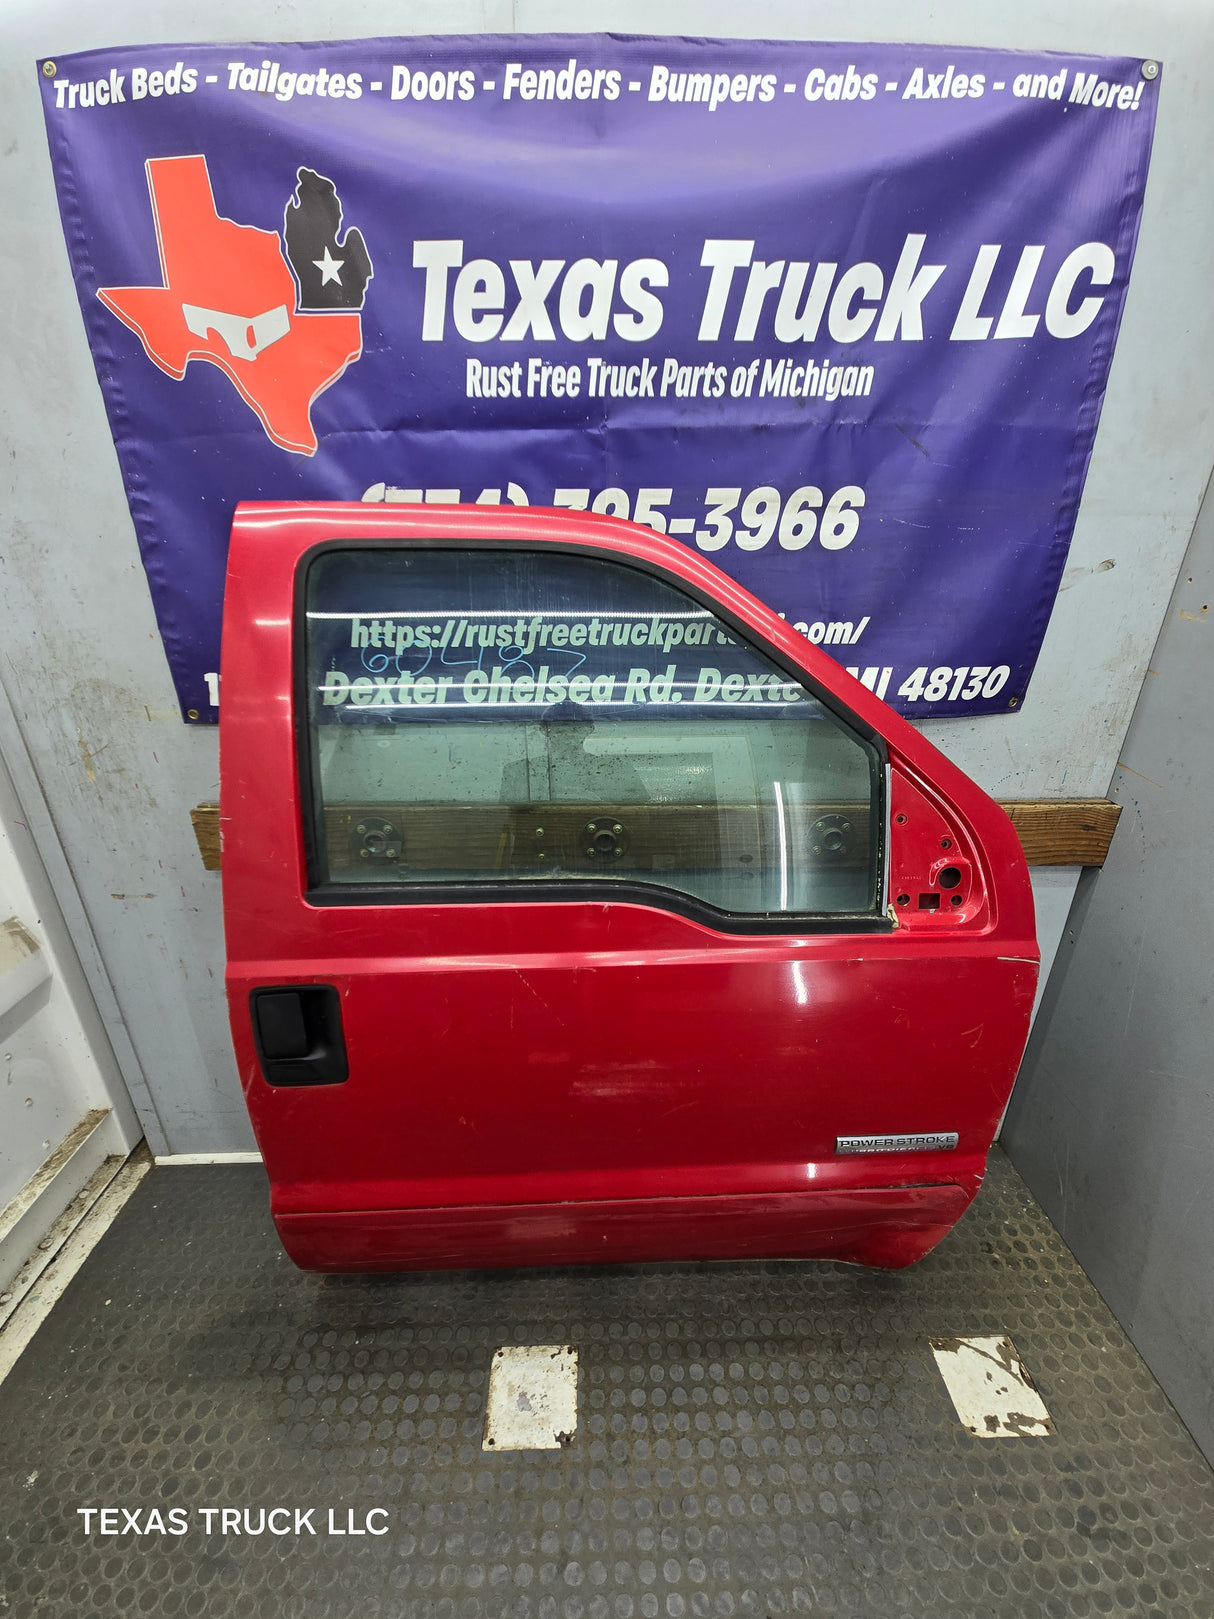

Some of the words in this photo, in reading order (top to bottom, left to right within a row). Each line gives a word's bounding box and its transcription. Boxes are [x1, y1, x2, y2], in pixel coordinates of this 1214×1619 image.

[53, 66, 126, 109] Truck
[131, 61, 198, 97] Beds
[227, 62, 363, 102] Tailgates
[390, 64, 475, 101] Doors
[503, 59, 621, 101] Fenders
[648, 65, 777, 112] Bumpers
[804, 66, 878, 101] Cabs
[902, 65, 986, 99] Axles
[1012, 68, 1068, 100] and
[1069, 72, 1146, 110] More!
[412, 239, 670, 342] Texas
[697, 232, 947, 343] Truck
[949, 241, 1116, 341] LLC
[466, 358, 522, 398] Rust
[526, 358, 581, 398] Free
[587, 357, 657, 398] Truck
[659, 358, 727, 399] Parts
[730, 359, 759, 398] of
[758, 357, 875, 402] Michigan
[322, 669, 453, 706] Dexter
[463, 665, 616, 705] Chelsea
[623, 664, 683, 703] Rd.
[897, 665, 1011, 702] 48130
[839, 1139, 894, 1147] POWER
[896, 1135, 956, 1145] STROKE
